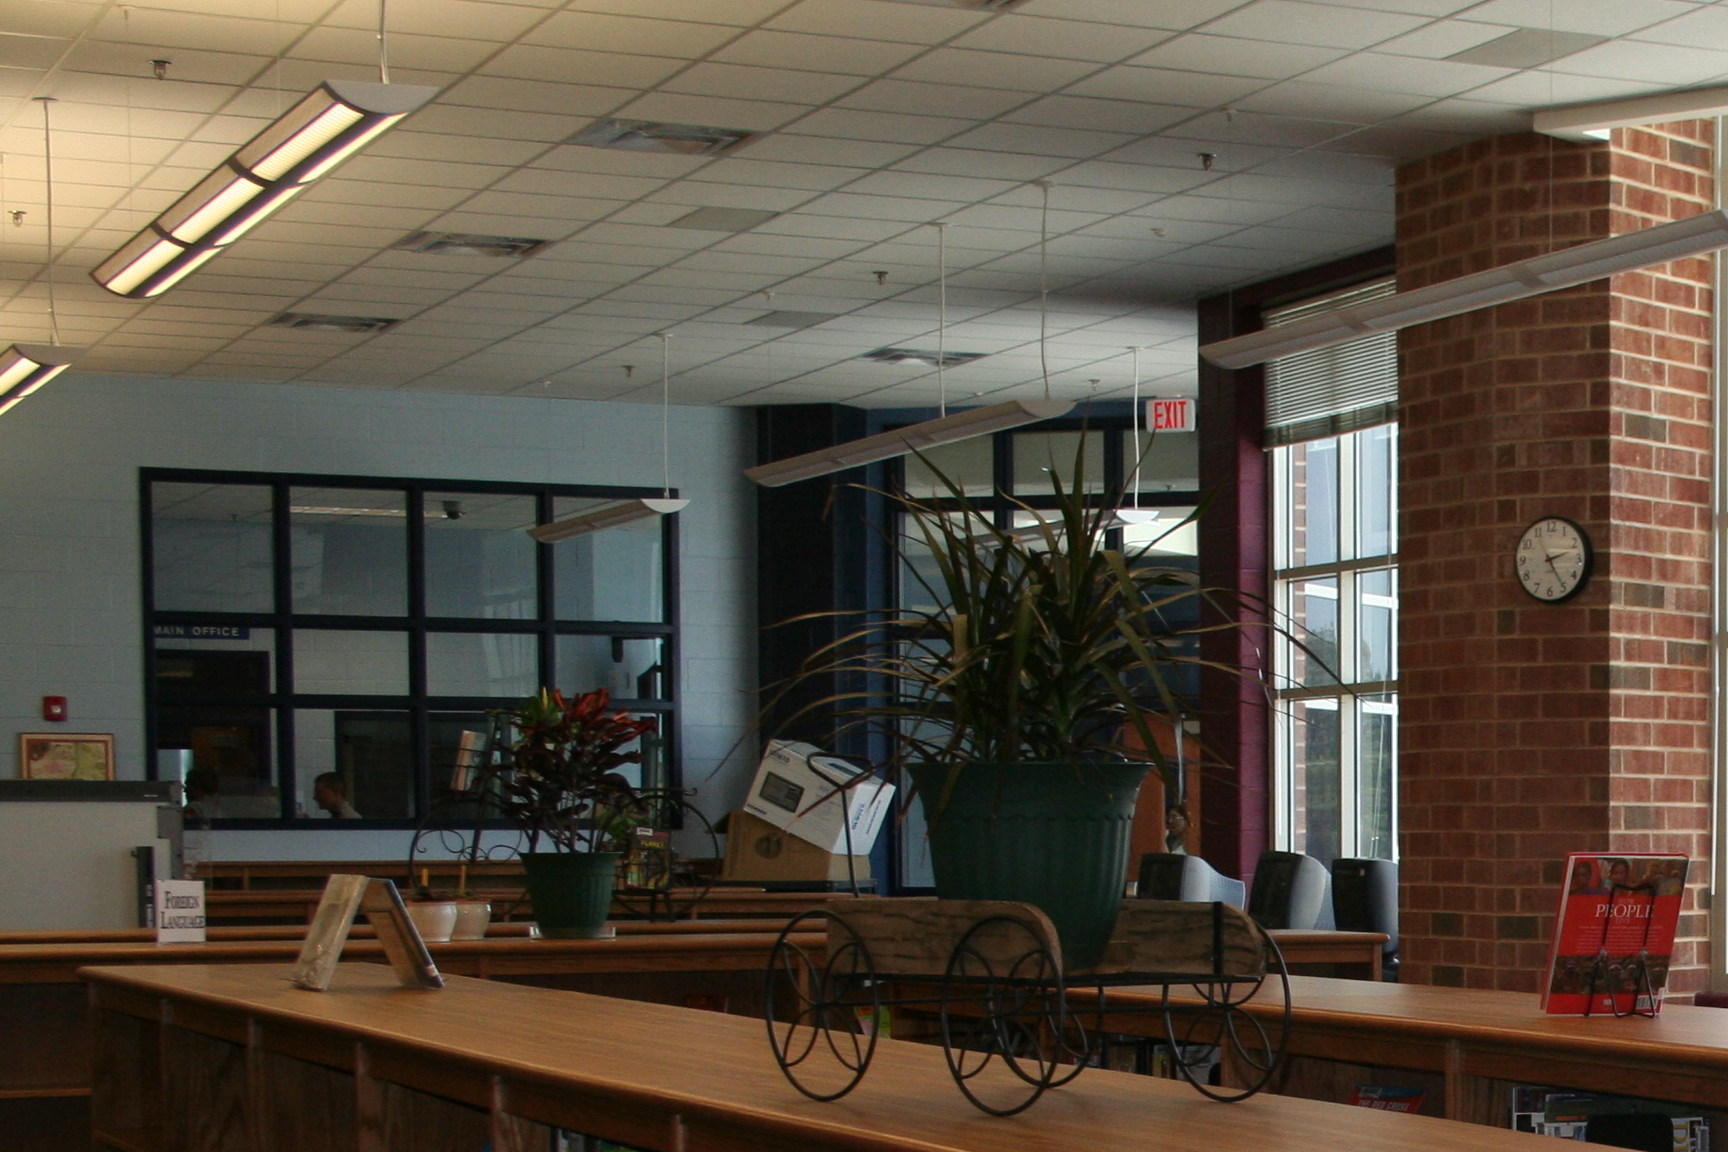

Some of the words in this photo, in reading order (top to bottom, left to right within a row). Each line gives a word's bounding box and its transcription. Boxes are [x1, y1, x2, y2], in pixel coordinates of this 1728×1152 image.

[1154, 401, 1186, 429] EXIT
[1535, 527, 1542, 537] 11
[1547, 521, 1556, 532] 12
[1562, 526, 1566, 536] 1
[1572, 538, 1578, 548] 2
[1519, 556, 1526, 566] 9
[1523, 570, 1530, 581] 8
[1571, 571, 1577, 580] 4
[1534, 583, 1540, 593] 7
[1547, 586, 1553, 597] 6
[1560, 582, 1566, 592] 5
[153, 625, 184, 635] MAIN
[191, 626, 239, 636] OFFICE
[164, 891, 199, 909] FOREIGN
[1595, 903, 1655, 918] PEOPLE
[160, 911, 205, 929] LANGUAGE
